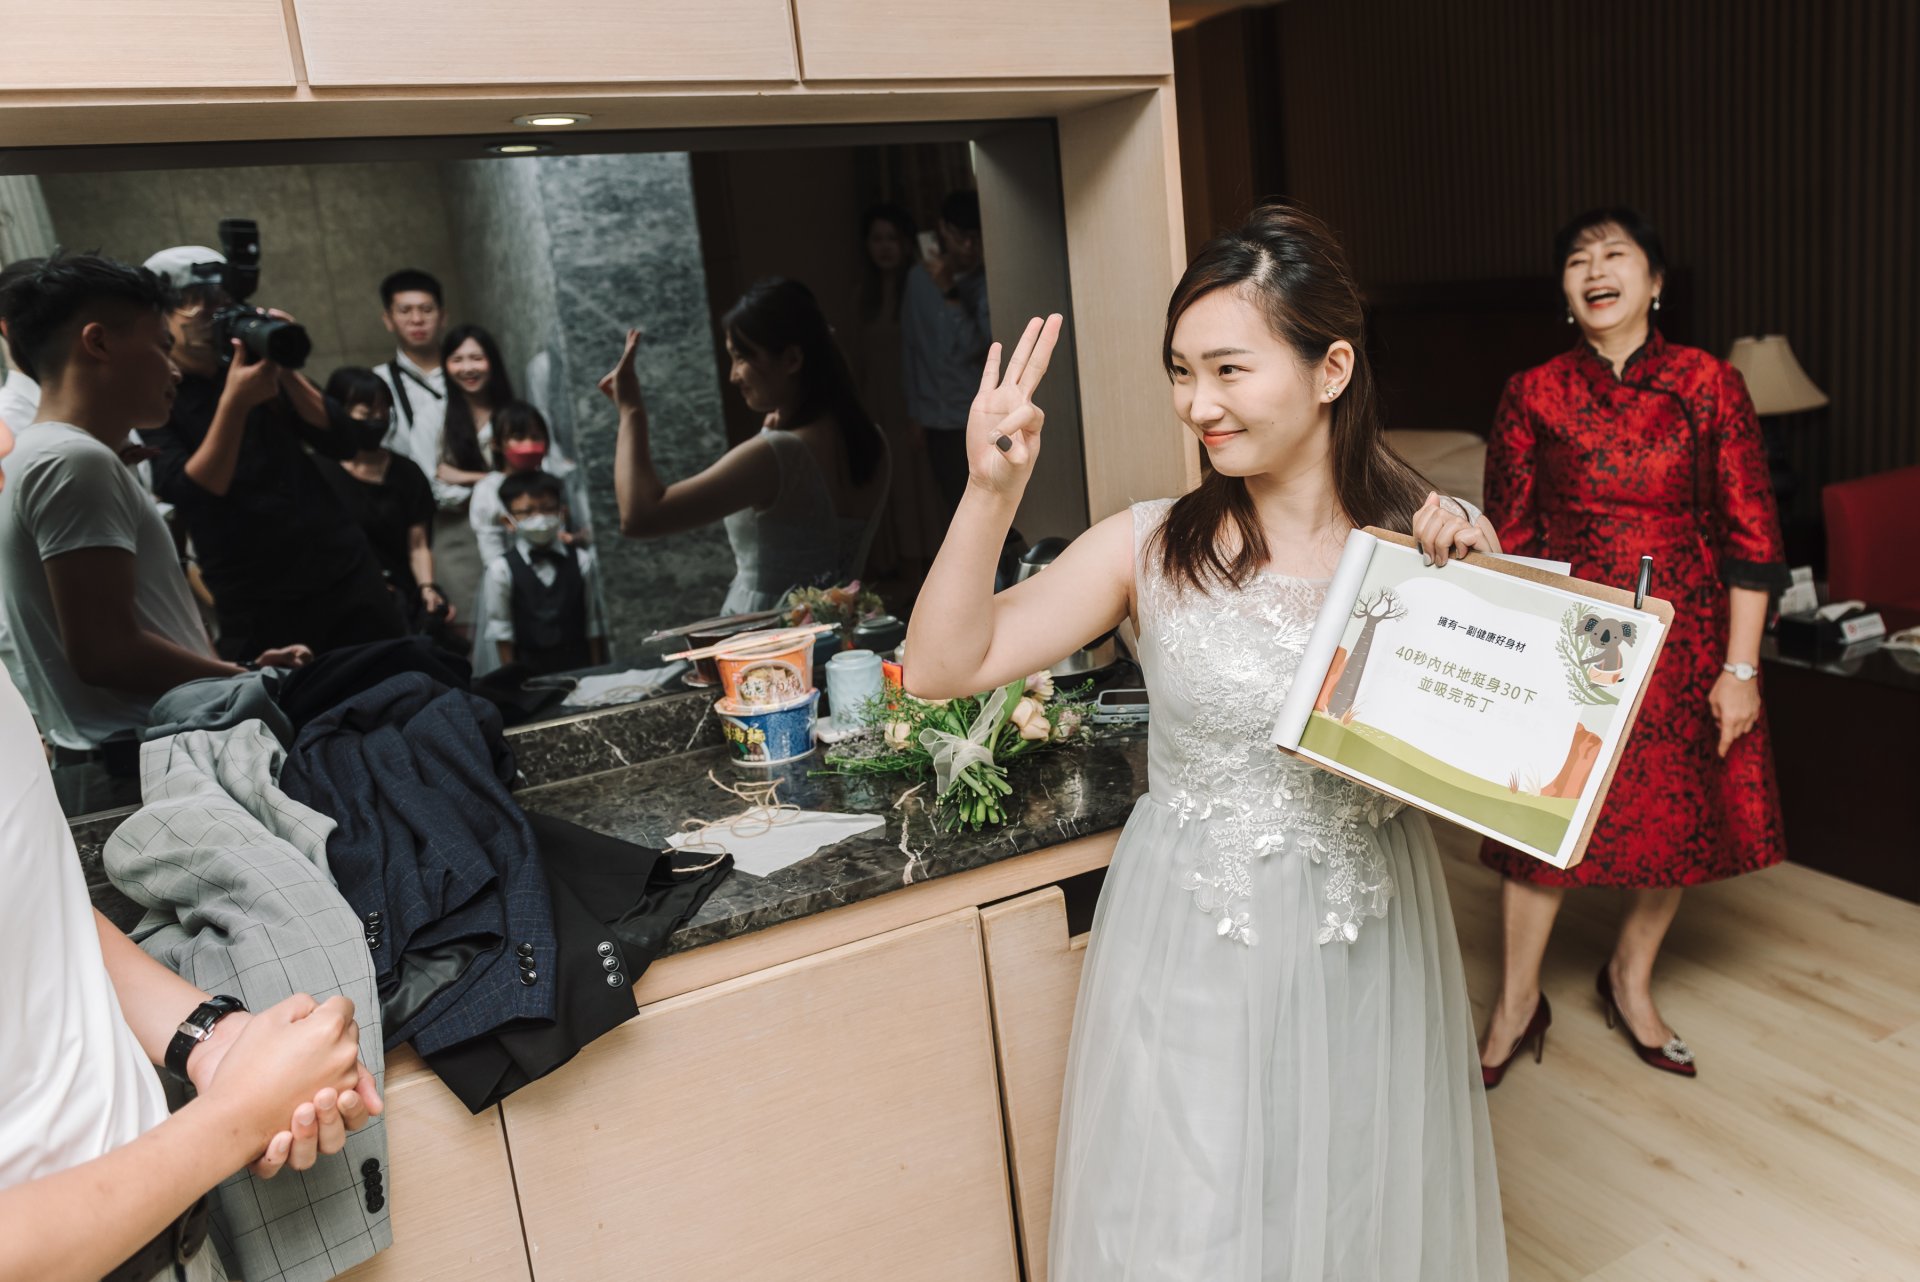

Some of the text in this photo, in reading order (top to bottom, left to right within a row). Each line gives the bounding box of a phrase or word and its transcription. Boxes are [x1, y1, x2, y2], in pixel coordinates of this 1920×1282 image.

[1437, 616, 1526, 653] 擁有一副健康好身材
[1395, 646, 1537, 704] 40秒內伏地挺身30下
[1418, 677, 1494, 712] 並吸完布丁
